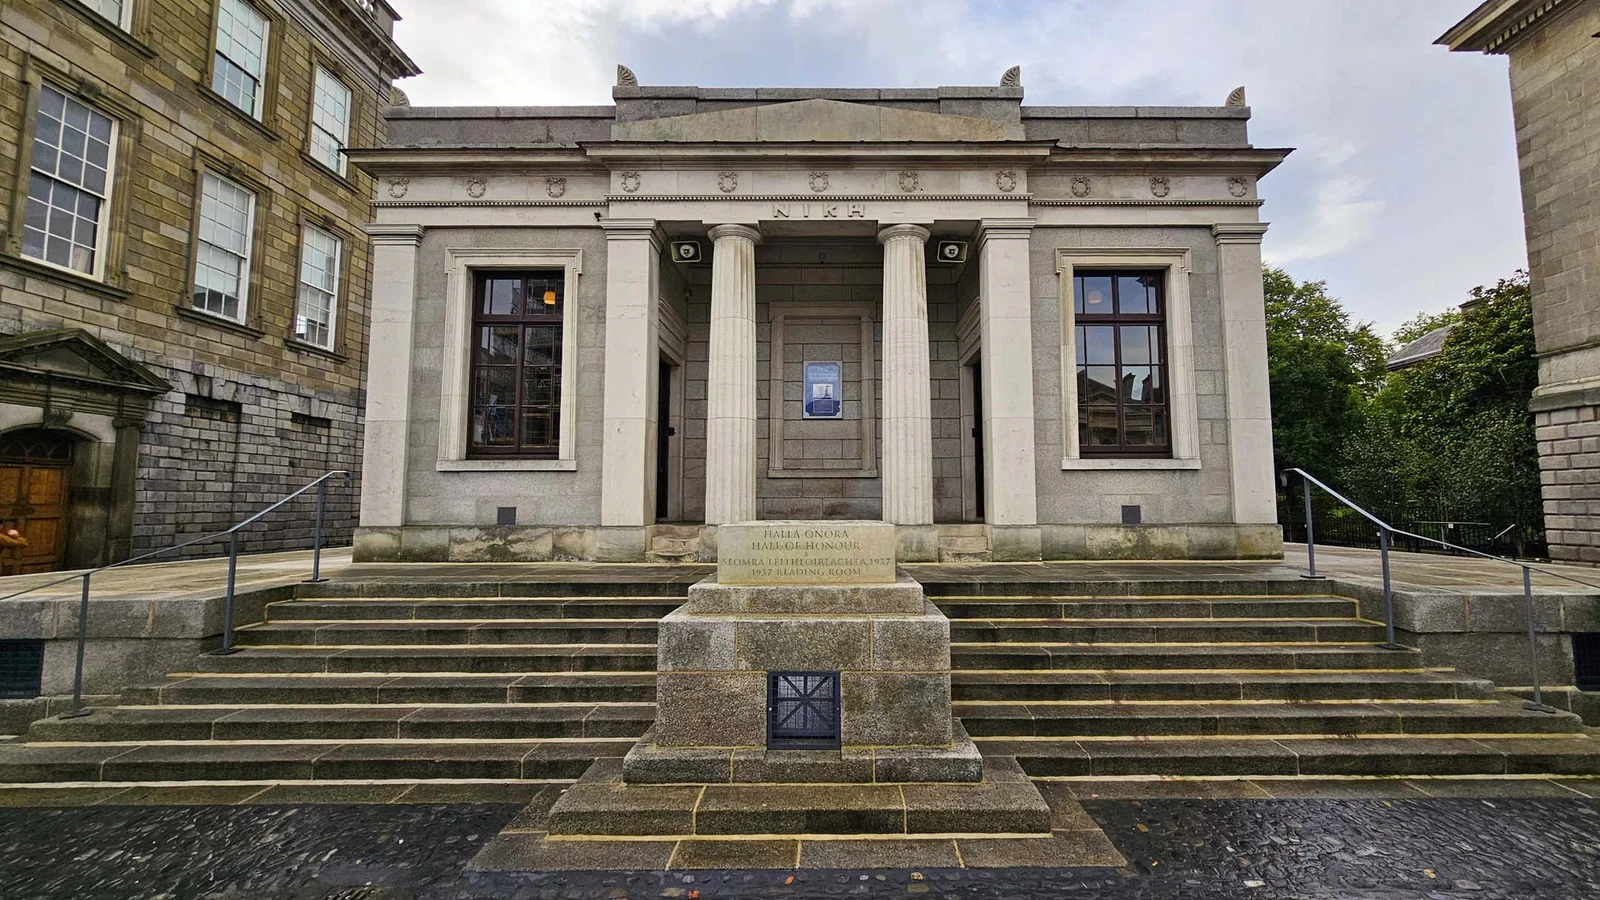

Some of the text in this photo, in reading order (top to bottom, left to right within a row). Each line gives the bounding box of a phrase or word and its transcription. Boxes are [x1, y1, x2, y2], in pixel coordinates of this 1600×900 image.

[752, 541, 861, 551] HALL OF HONOUR
[722, 558, 765, 566] SEOMRA
[870, 557, 891, 566] 1937
[752, 568, 861, 576] 1937 READING ROOM
